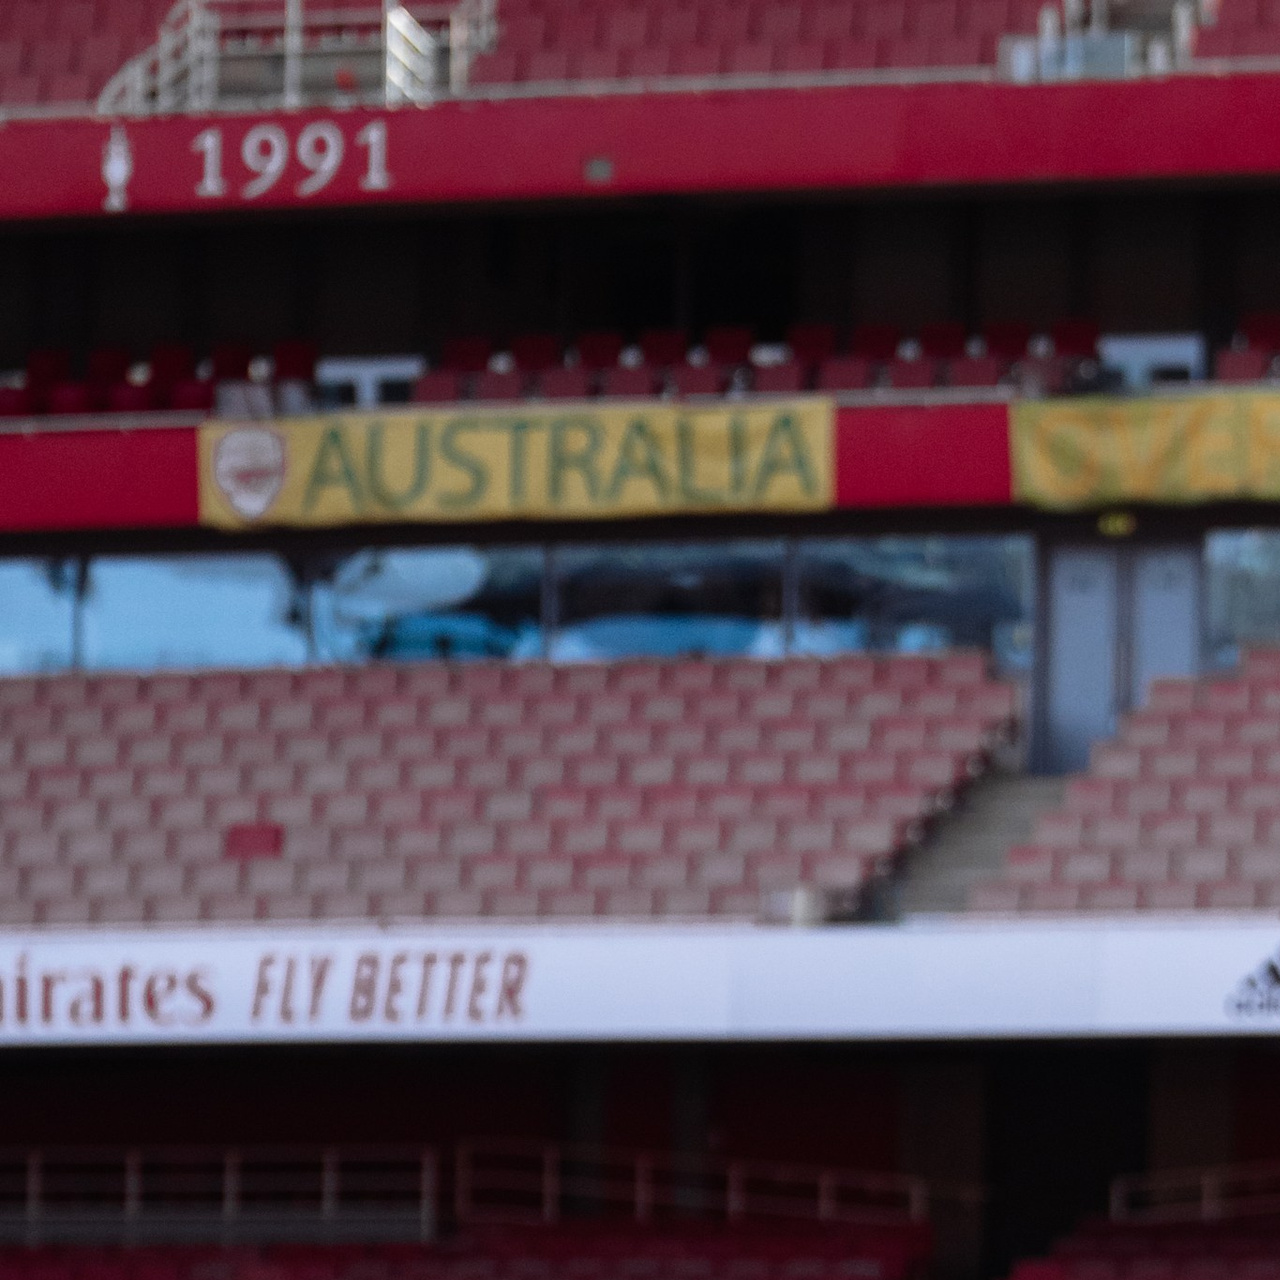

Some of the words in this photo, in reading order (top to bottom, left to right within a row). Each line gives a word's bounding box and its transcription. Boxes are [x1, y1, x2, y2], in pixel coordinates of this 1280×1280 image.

[191, 119, 392, 199] 1991
[303, 402, 820, 515] AUSTRALIA
[0, 950, 216, 1026] irates
[250, 950, 334, 1026] FLY
[348, 950, 529, 1024] BETTER
